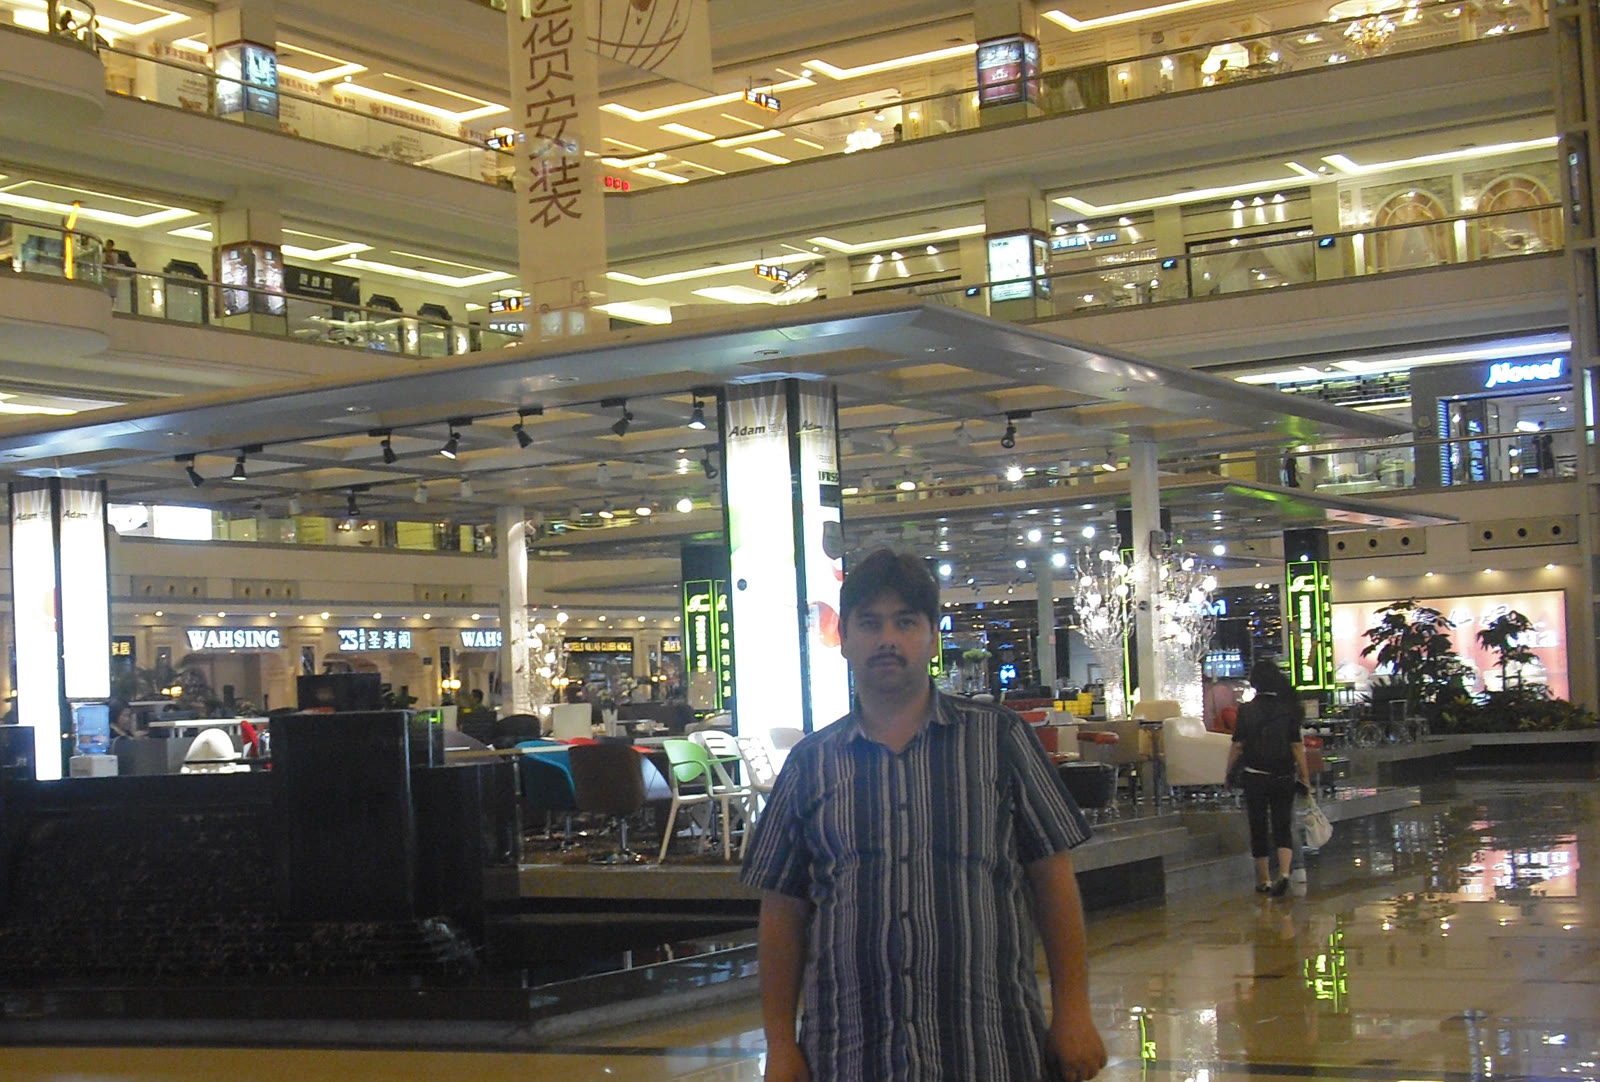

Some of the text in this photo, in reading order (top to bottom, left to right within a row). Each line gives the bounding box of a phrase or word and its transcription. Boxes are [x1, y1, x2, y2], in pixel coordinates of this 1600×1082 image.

[729, 425, 766, 437] Adam
[63, 509, 88, 519] Adam
[187, 629, 280, 650] WAHSING
